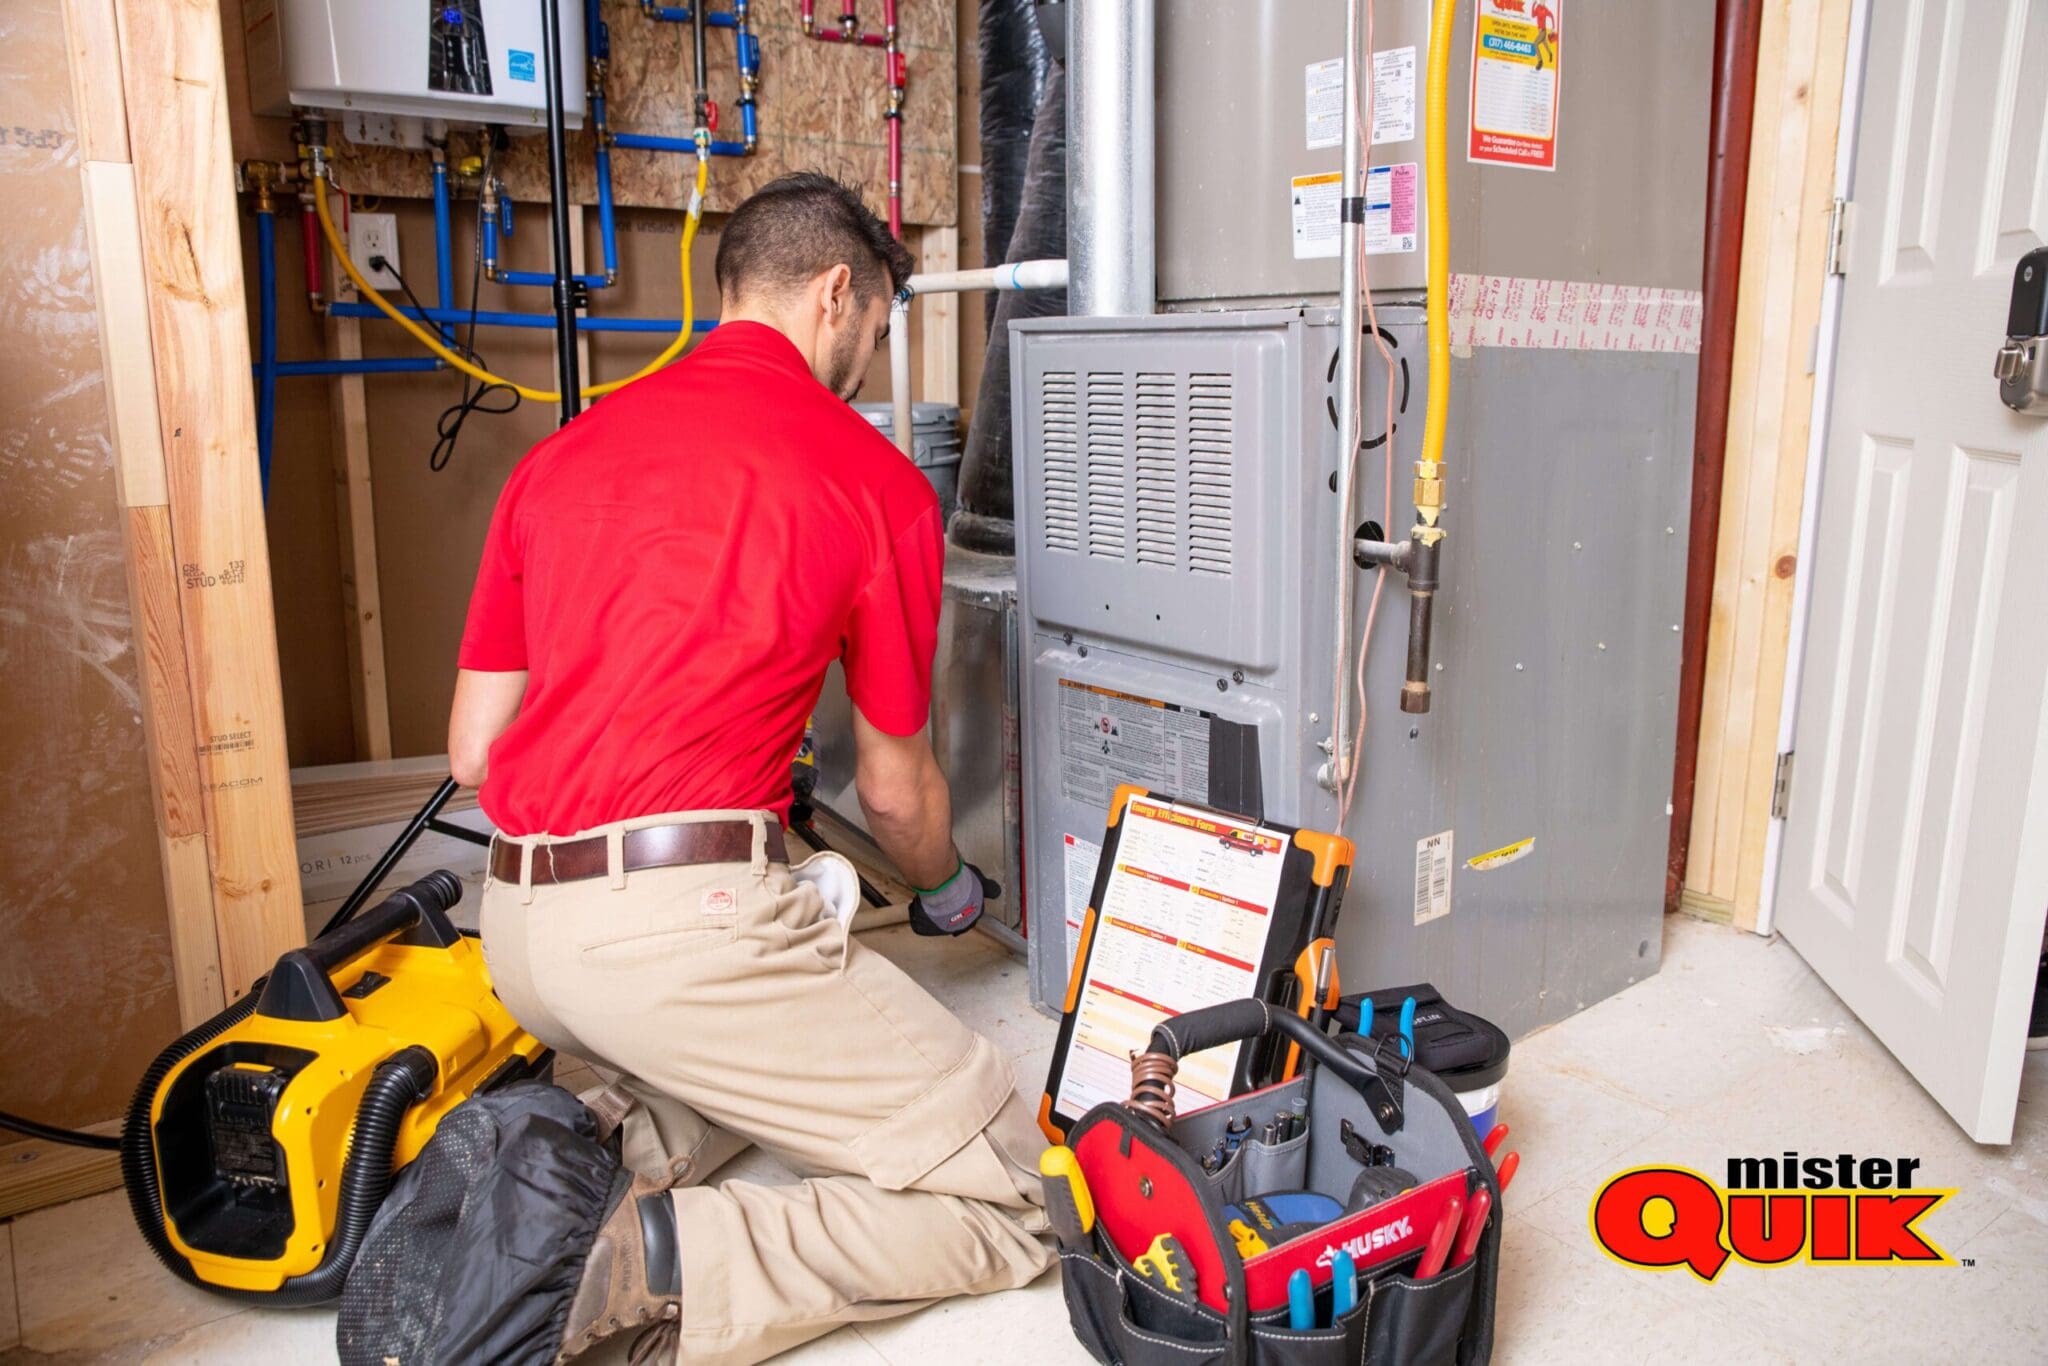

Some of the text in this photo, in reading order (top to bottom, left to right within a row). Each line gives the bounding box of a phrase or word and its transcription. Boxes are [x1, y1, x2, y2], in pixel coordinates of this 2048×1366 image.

[186, 576, 216, 589] STUD
[209, 734, 228, 743] STUD
[1132, 802, 1156, 818] Energy
[1196, 819, 1216, 833] Form
[1427, 837, 1441, 848] NN
[339, 855, 353, 865] 12
[1341, 1216, 1411, 1259] HUSKY
